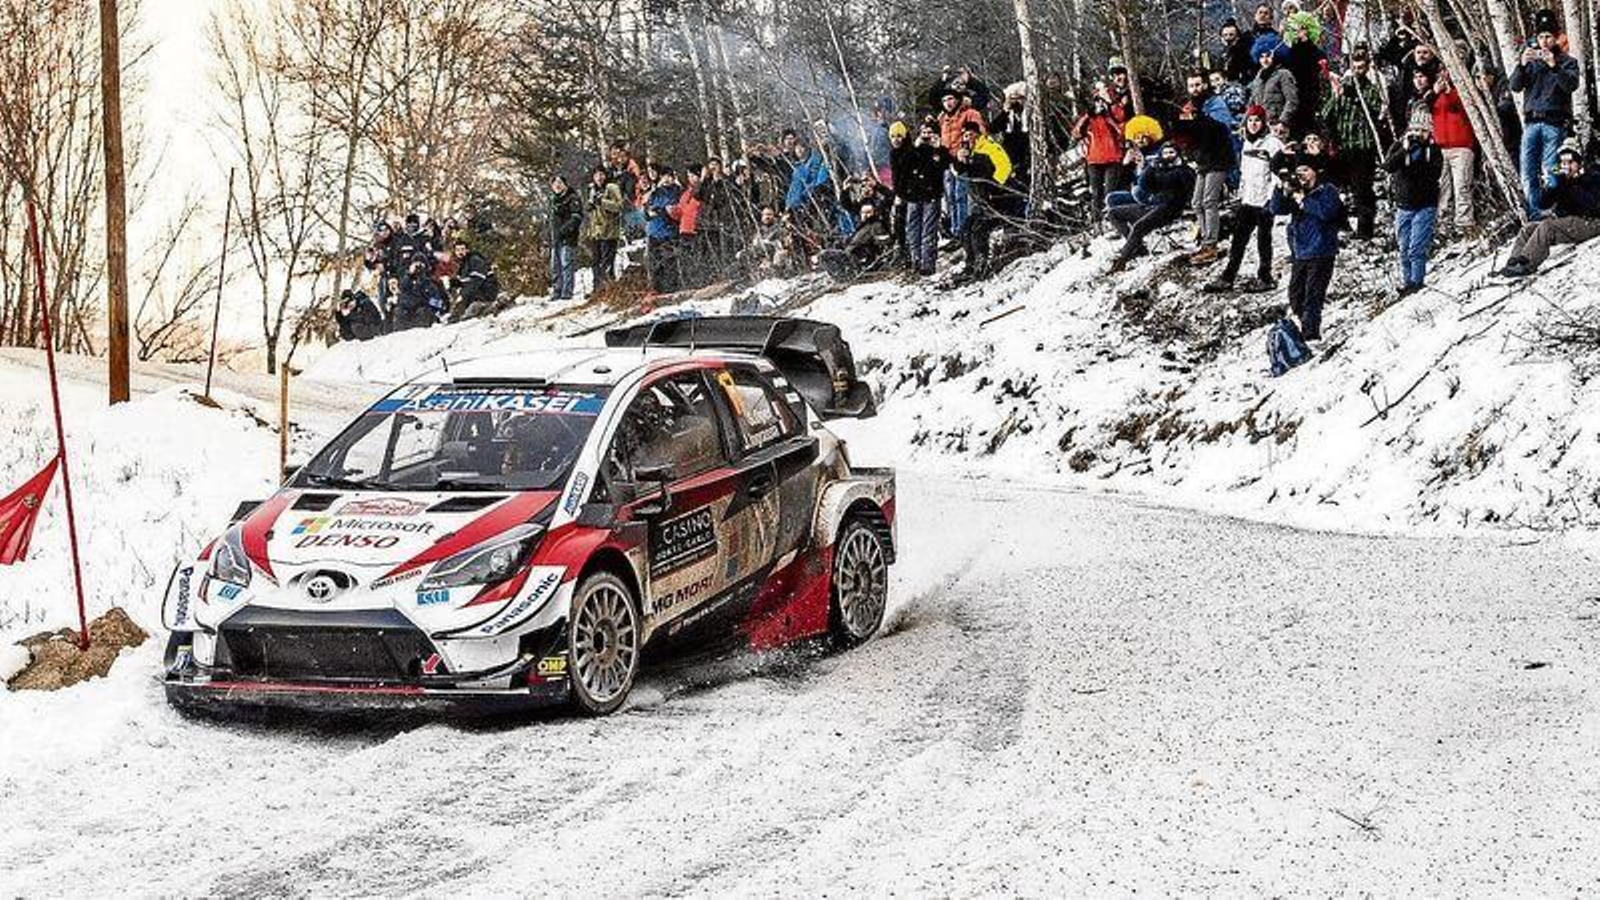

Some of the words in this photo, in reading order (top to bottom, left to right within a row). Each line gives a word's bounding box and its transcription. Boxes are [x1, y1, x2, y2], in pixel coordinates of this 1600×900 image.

[330, 518, 435, 535] Microsoft
[663, 510, 711, 544] CASINO
[295, 535, 400, 549] DENSO
[173, 566, 194, 626] Panasonic
[480, 572, 559, 634] Panasonic
[537, 658, 567, 673] OMP
